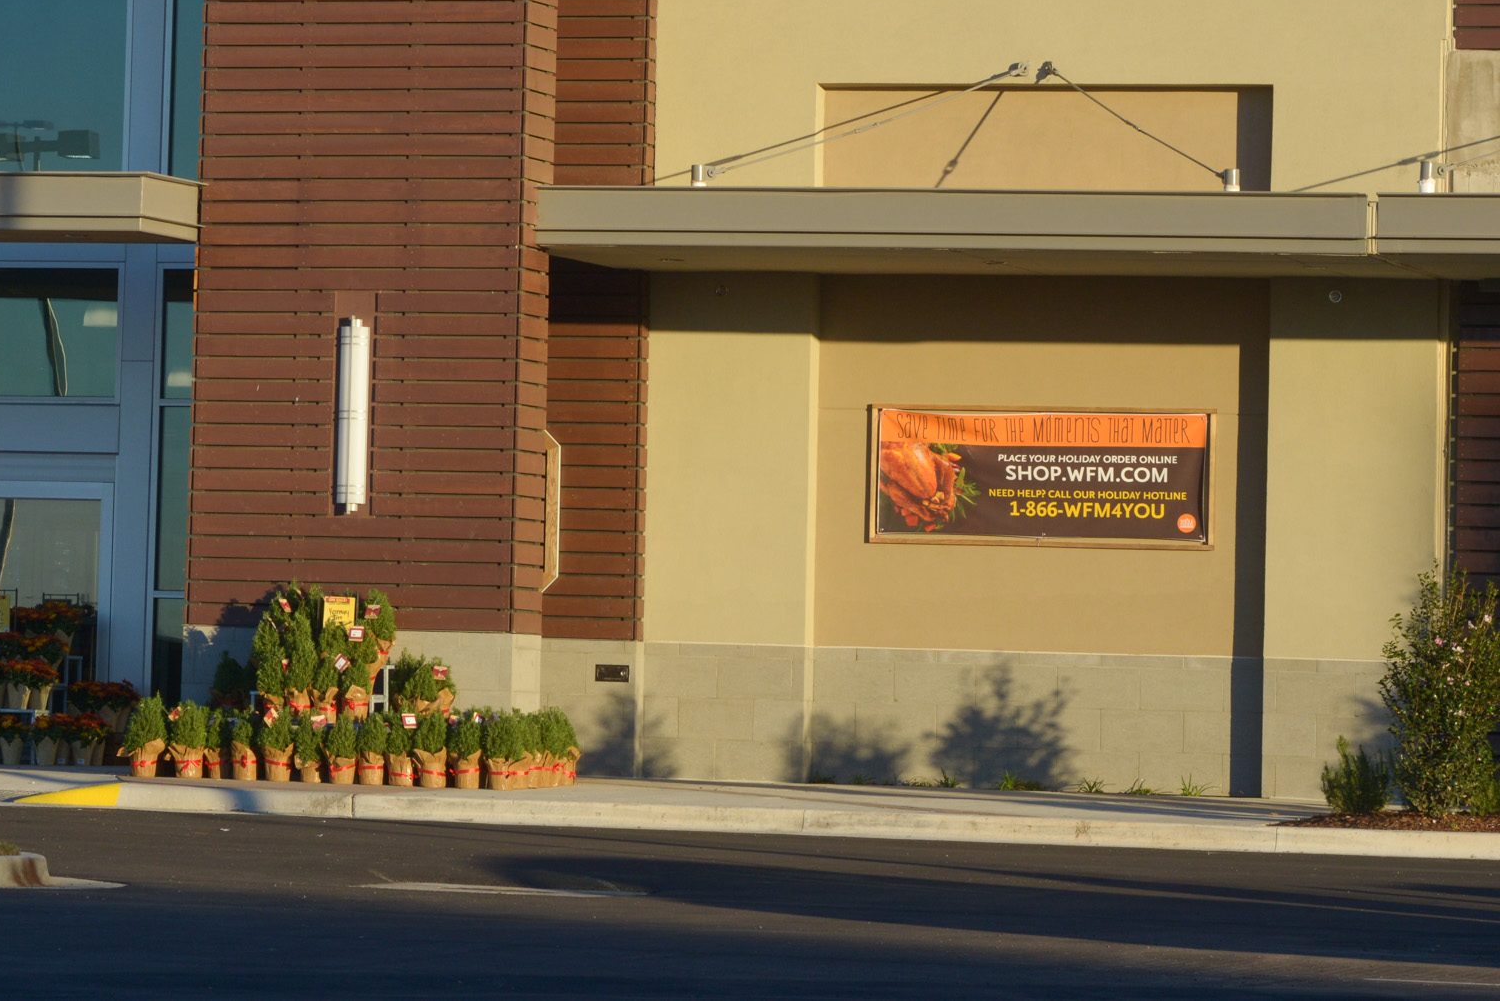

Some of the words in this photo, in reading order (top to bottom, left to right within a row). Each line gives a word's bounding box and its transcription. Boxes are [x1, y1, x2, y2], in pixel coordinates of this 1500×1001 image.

[997, 454, 1027, 462] PLACE
[1029, 454, 1056, 463] YOUR
[1058, 455, 1101, 463] HOLIDAY
[1102, 455, 1137, 464] ORDER
[1139, 455, 1178, 464] ONLINE
[1005, 465, 1168, 483] SHOP.WFM.COM
[988, 488, 1015, 497] NEED
[1017, 489, 1046, 498] HELP?
[1048, 490, 1071, 498] CALL
[1073, 490, 1096, 499] OUR
[1098, 491, 1141, 499] HOLIDAY
[1143, 491, 1187, 500] HOTLINE
[1009, 500, 1165, 519] 1-866-WFM4YOU
